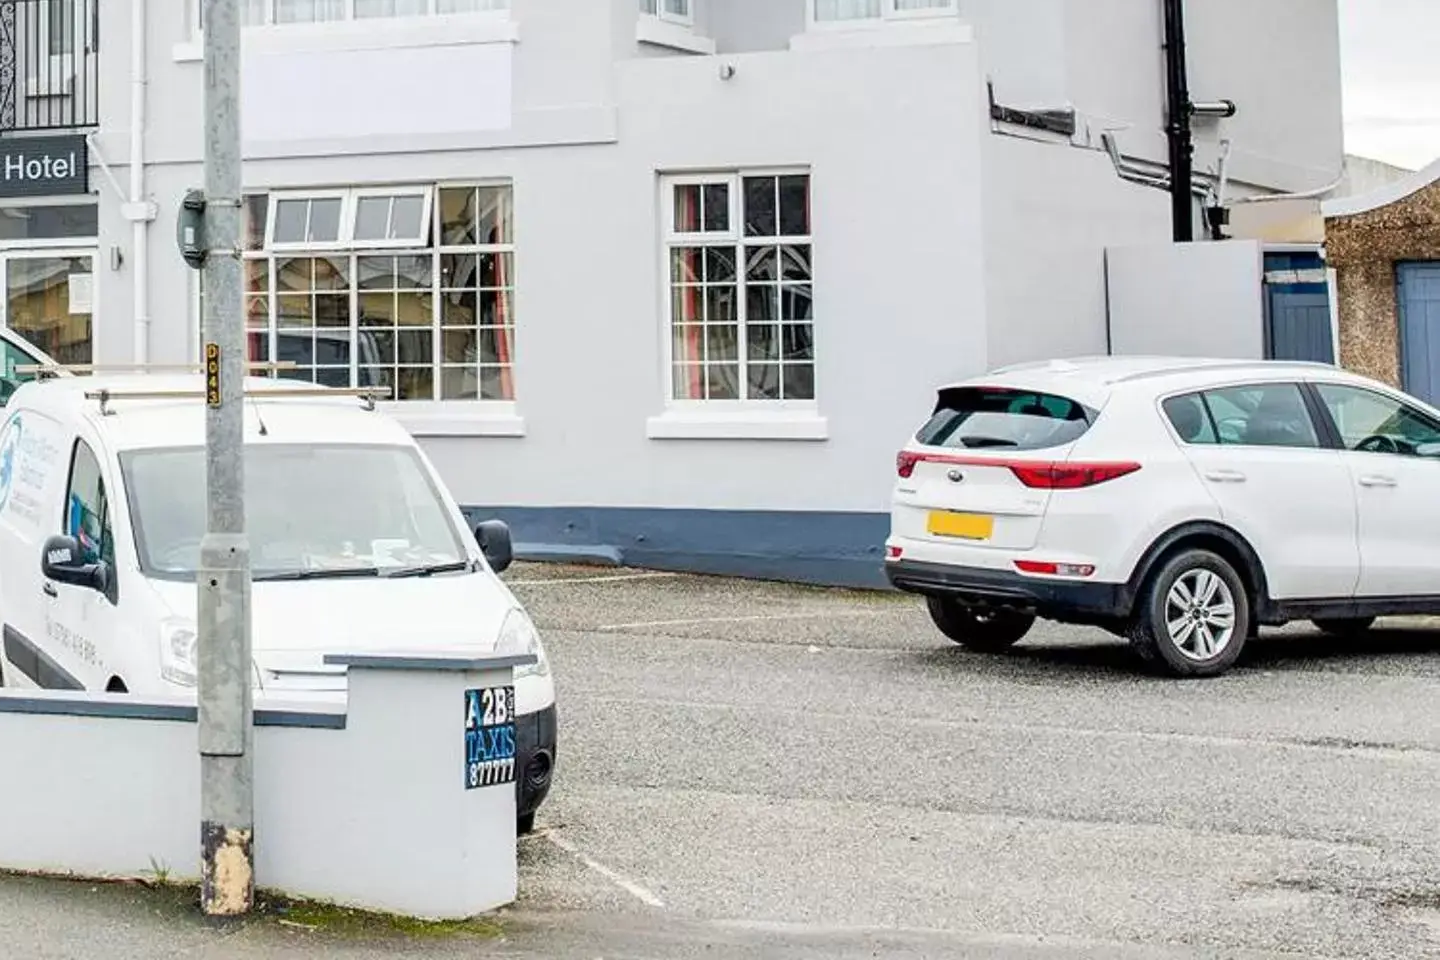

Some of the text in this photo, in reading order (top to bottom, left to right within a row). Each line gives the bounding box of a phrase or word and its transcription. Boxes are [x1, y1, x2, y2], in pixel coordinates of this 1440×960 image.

[5, 152, 75, 180] Hotel
[466, 725, 515, 763] TAXIS
[469, 757, 515, 787] 877777
